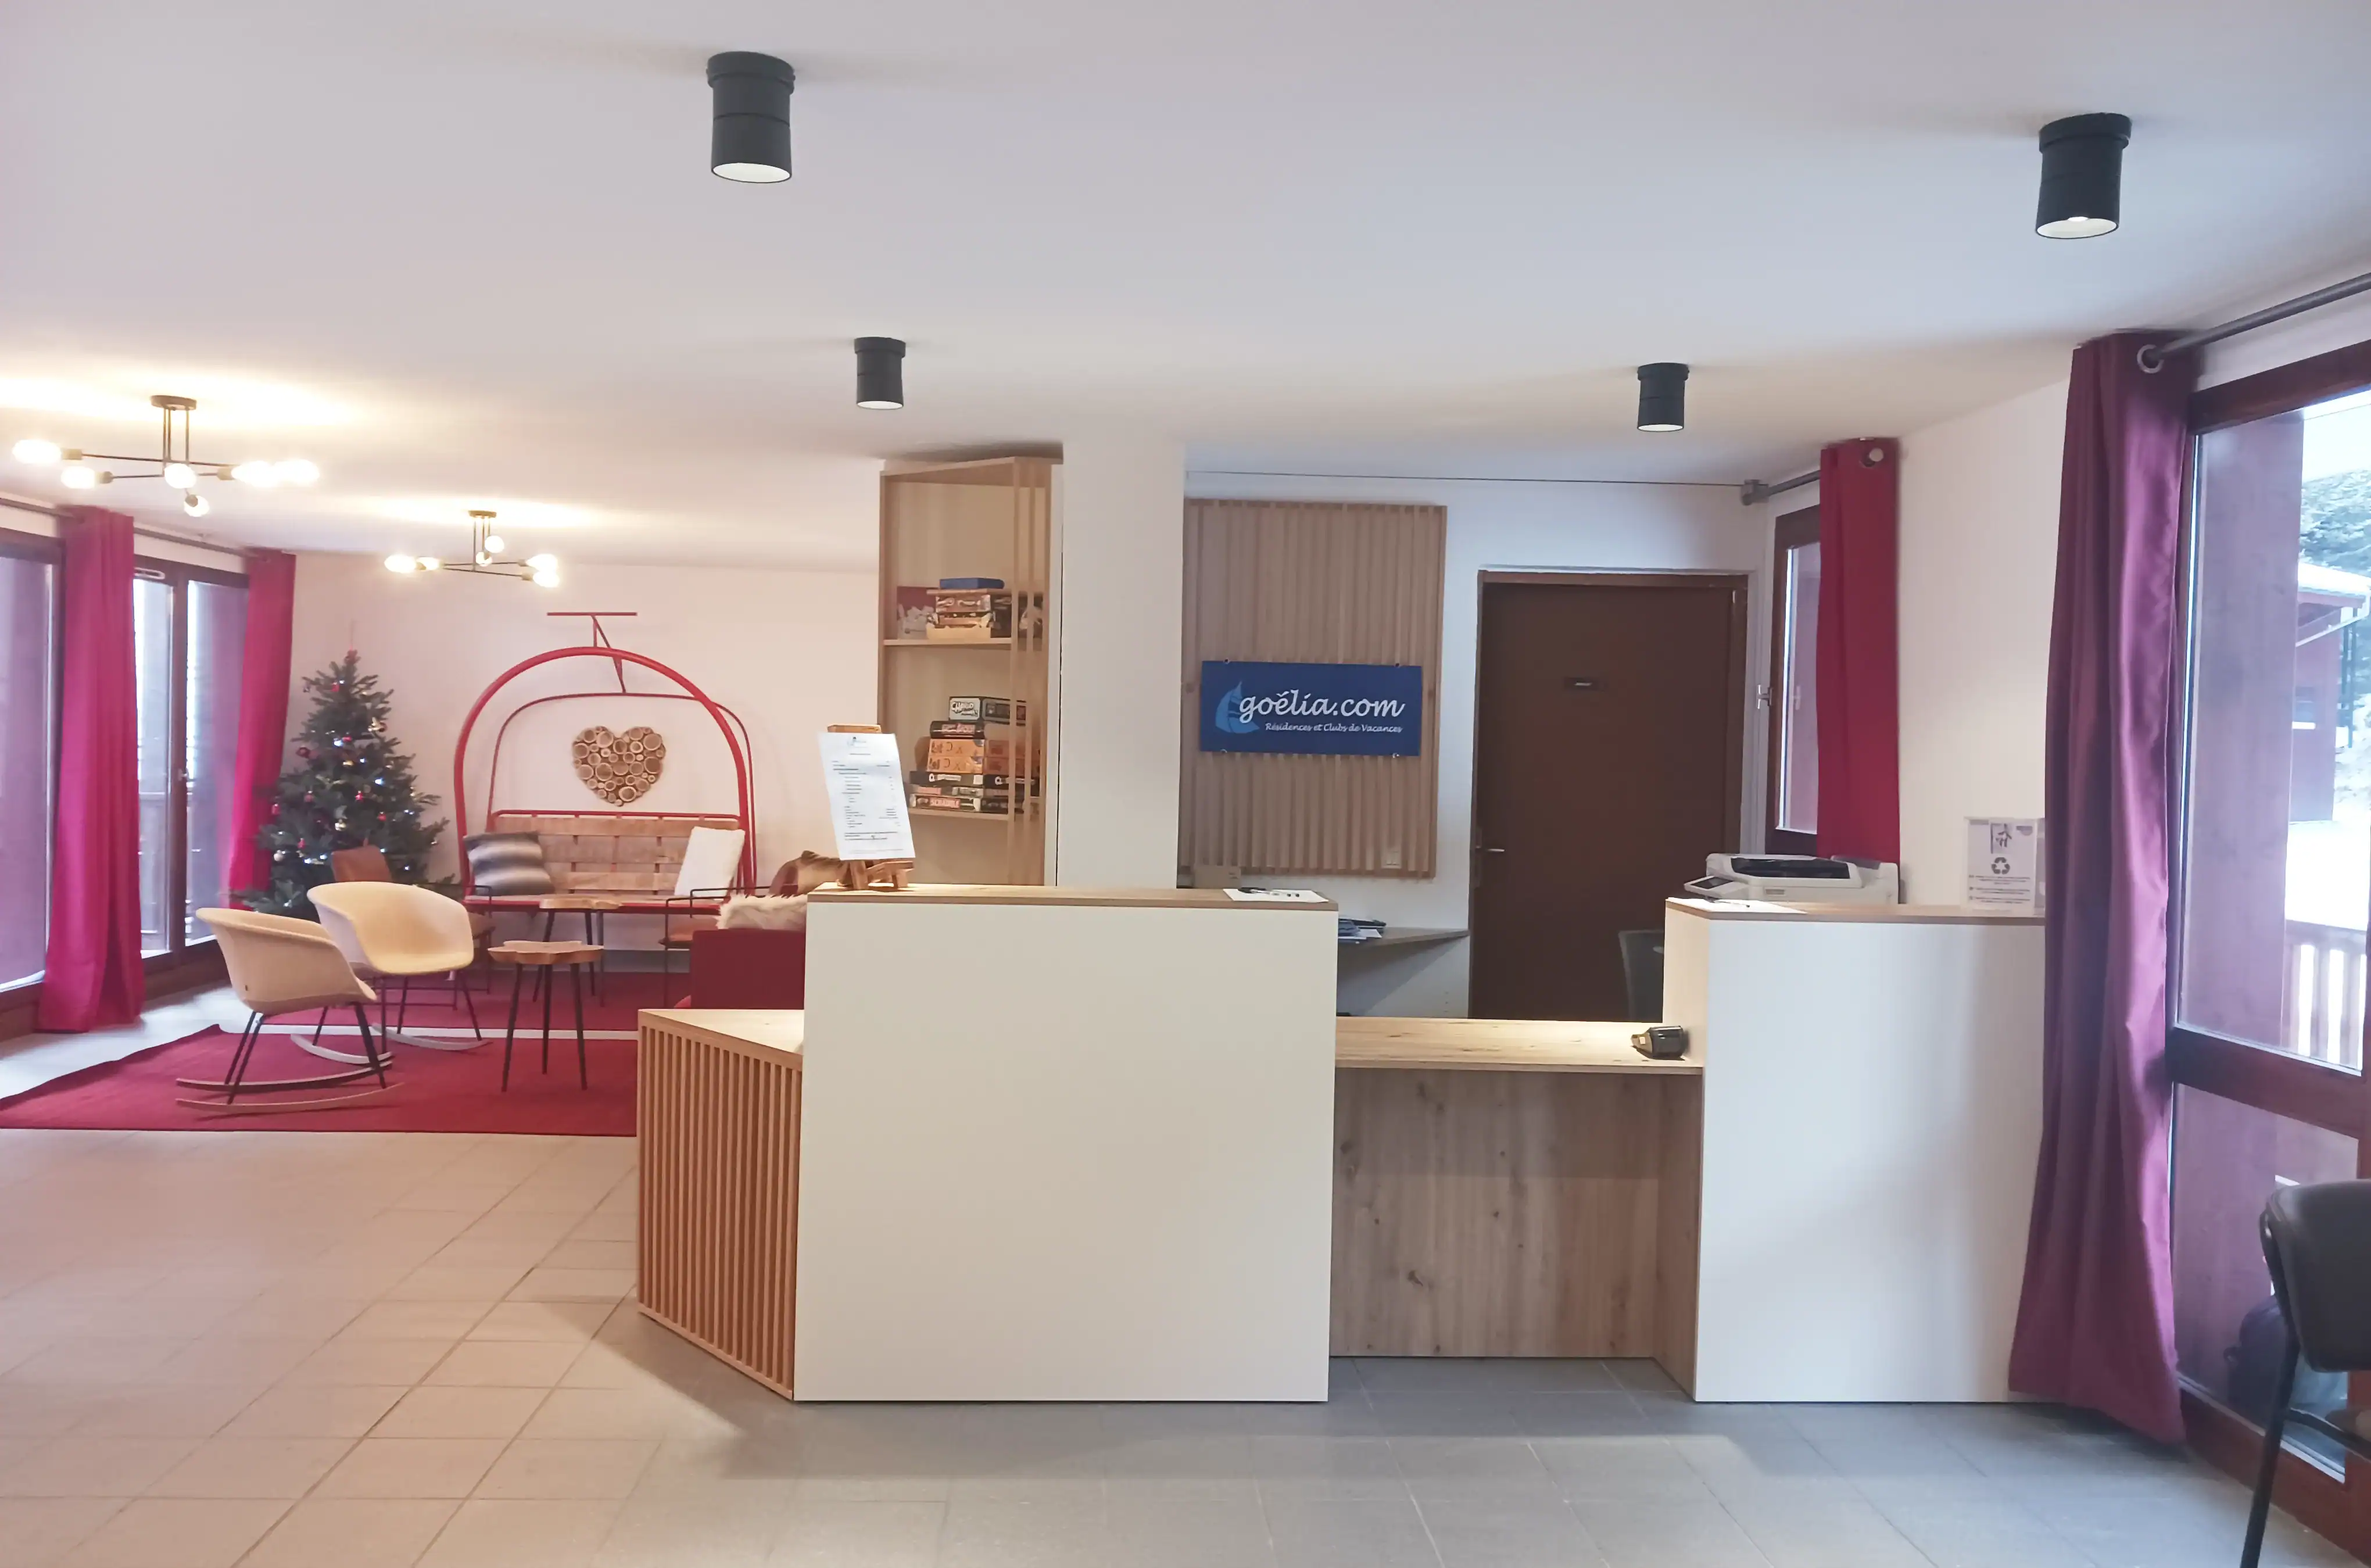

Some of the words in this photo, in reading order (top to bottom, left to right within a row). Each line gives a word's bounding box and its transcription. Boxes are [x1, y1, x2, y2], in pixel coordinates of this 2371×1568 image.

[1265, 722, 1313, 731] Résidences
[1324, 723, 1348, 732] Clubs
[1348, 723, 1360, 732] de
[1361, 724, 1403, 733] Vacances
